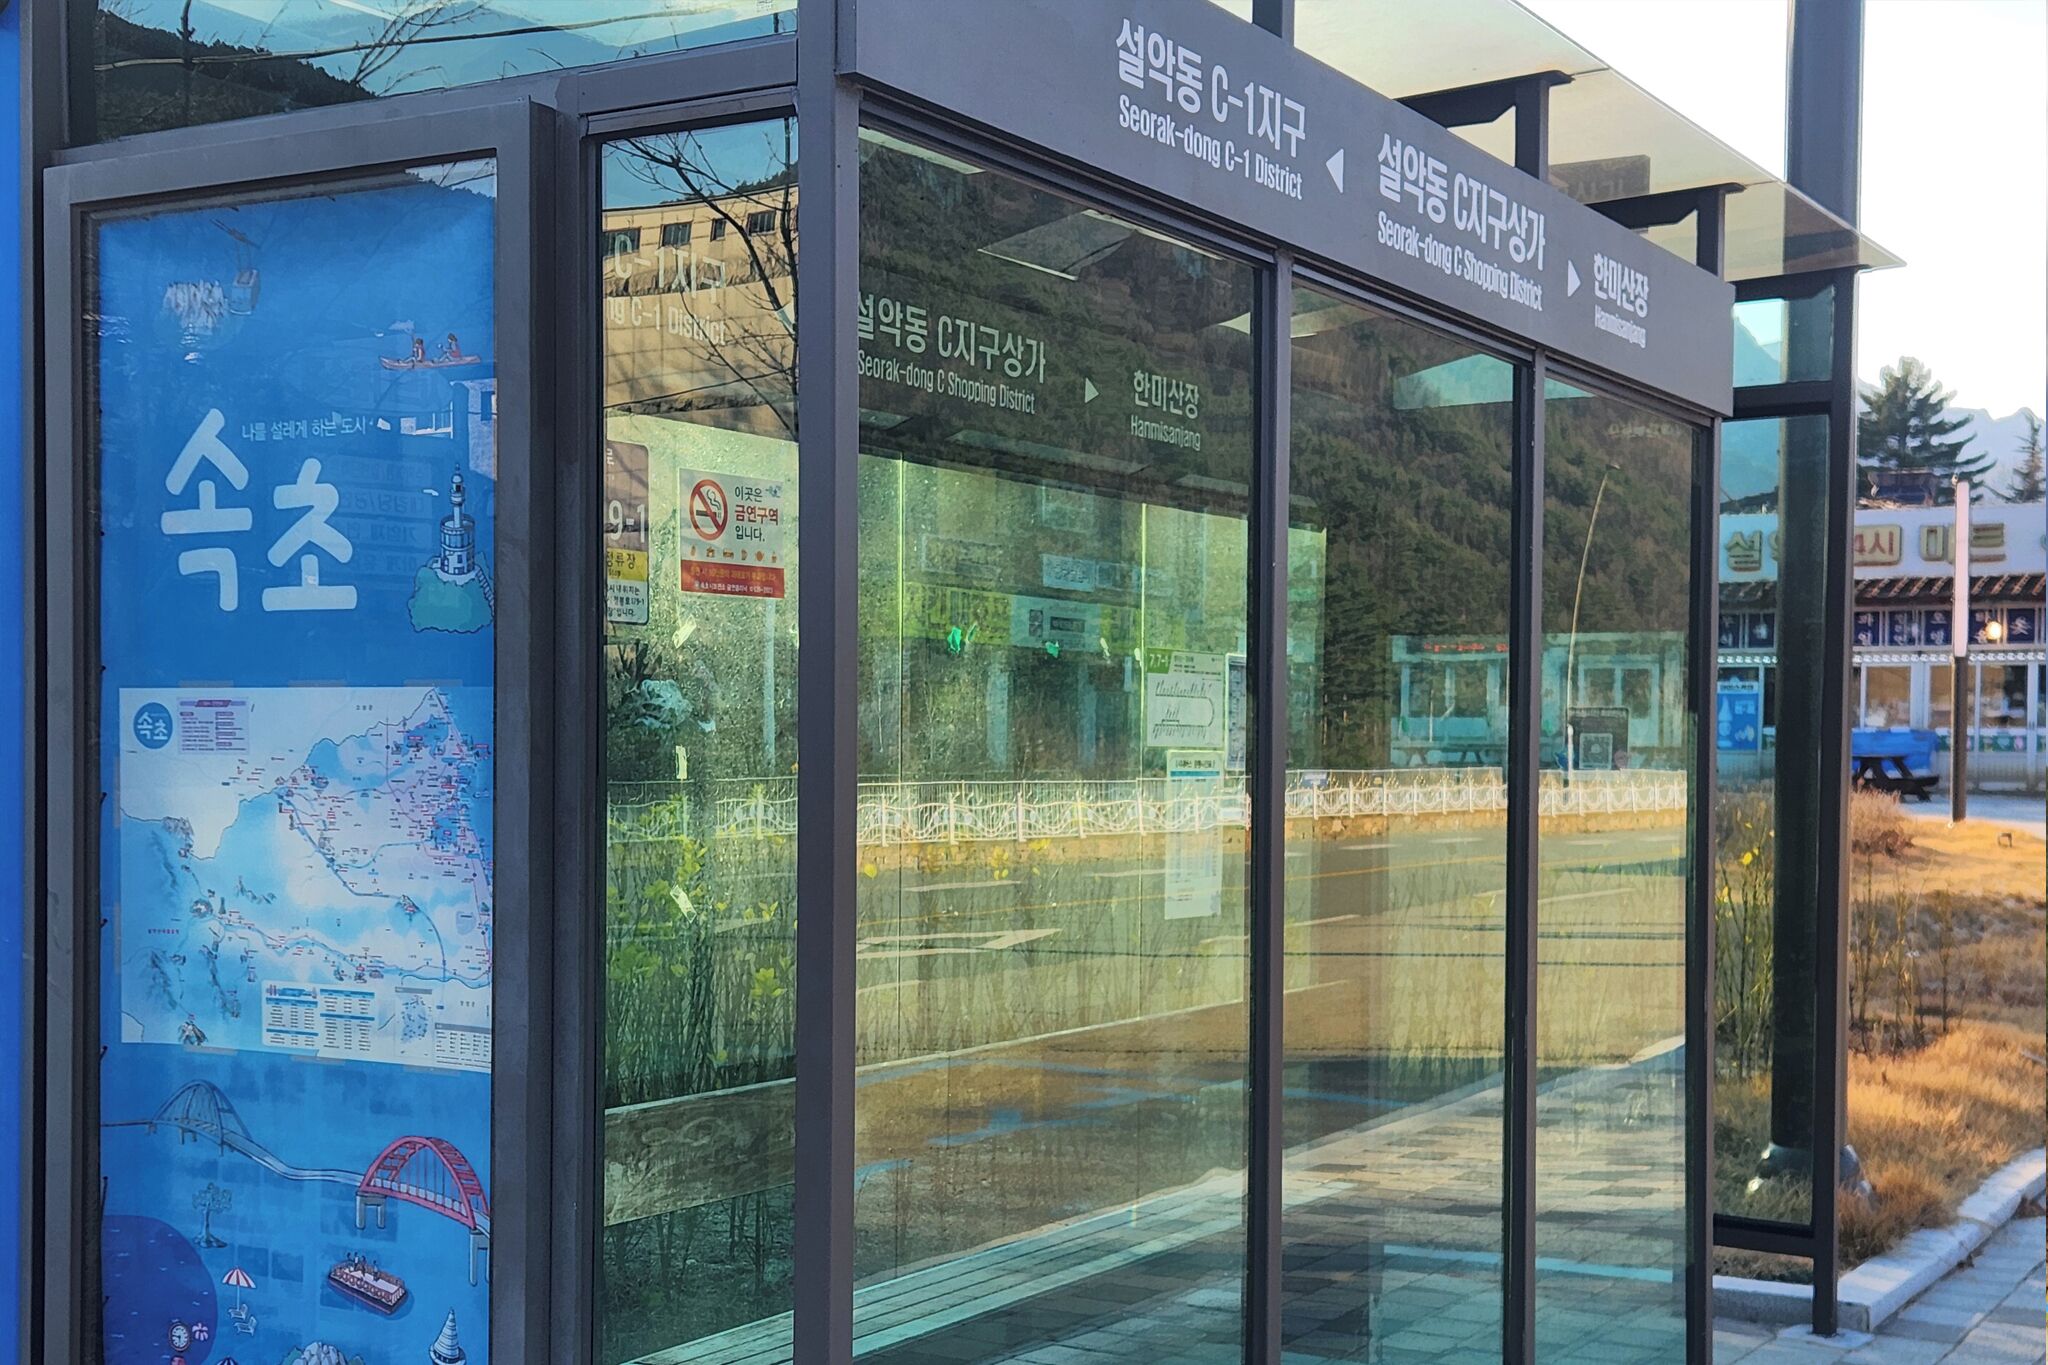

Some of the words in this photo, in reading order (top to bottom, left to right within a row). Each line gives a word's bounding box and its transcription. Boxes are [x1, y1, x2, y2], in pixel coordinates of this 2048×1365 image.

[1116, 18, 1203, 114] 설악동
[1211, 64, 1306, 158] C-1지구
[1119, 94, 1221, 169] Seorak-dong
[1225, 140, 1250, 178] C-1
[1255, 153, 1303, 200] District
[1378, 133, 1448, 224] 설악동
[1453, 172, 1546, 271] C지구상가
[614, 234, 726, 304] C-1지구
[1377, 210, 1452, 275] Seorak-dong
[1454, 251, 1463, 276] C
[1464, 251, 1508, 299] Shopping
[1510, 270, 1543, 312] District
[1594, 252, 1649, 318] 한미산장
[631, 296, 660, 330] C-1
[668, 307, 726, 346] District
[858, 291, 928, 353] 설악동
[938, 315, 1046, 384] C지구상가
[858, 349, 934, 392] Seorak-dong
[937, 369, 945, 393] C
[948, 371, 996, 408] Shopping
[1000, 384, 1035, 415] District
[1134, 370, 1199, 419] 한미산장
[242, 421, 266, 442] 나를
[270, 419, 307, 440] 설레게
[312, 417, 336, 437] 하는
[340, 415, 366, 435] 도시
[1131, 414, 1200, 451] Hanmisanjang
[160, 408, 358, 612] 속초
[734, 486, 763, 503] 이곳은
[734, 504, 779, 525] 금연구역
[735, 525, 765, 542] 입니다.
[137, 712, 168, 740] 속초
